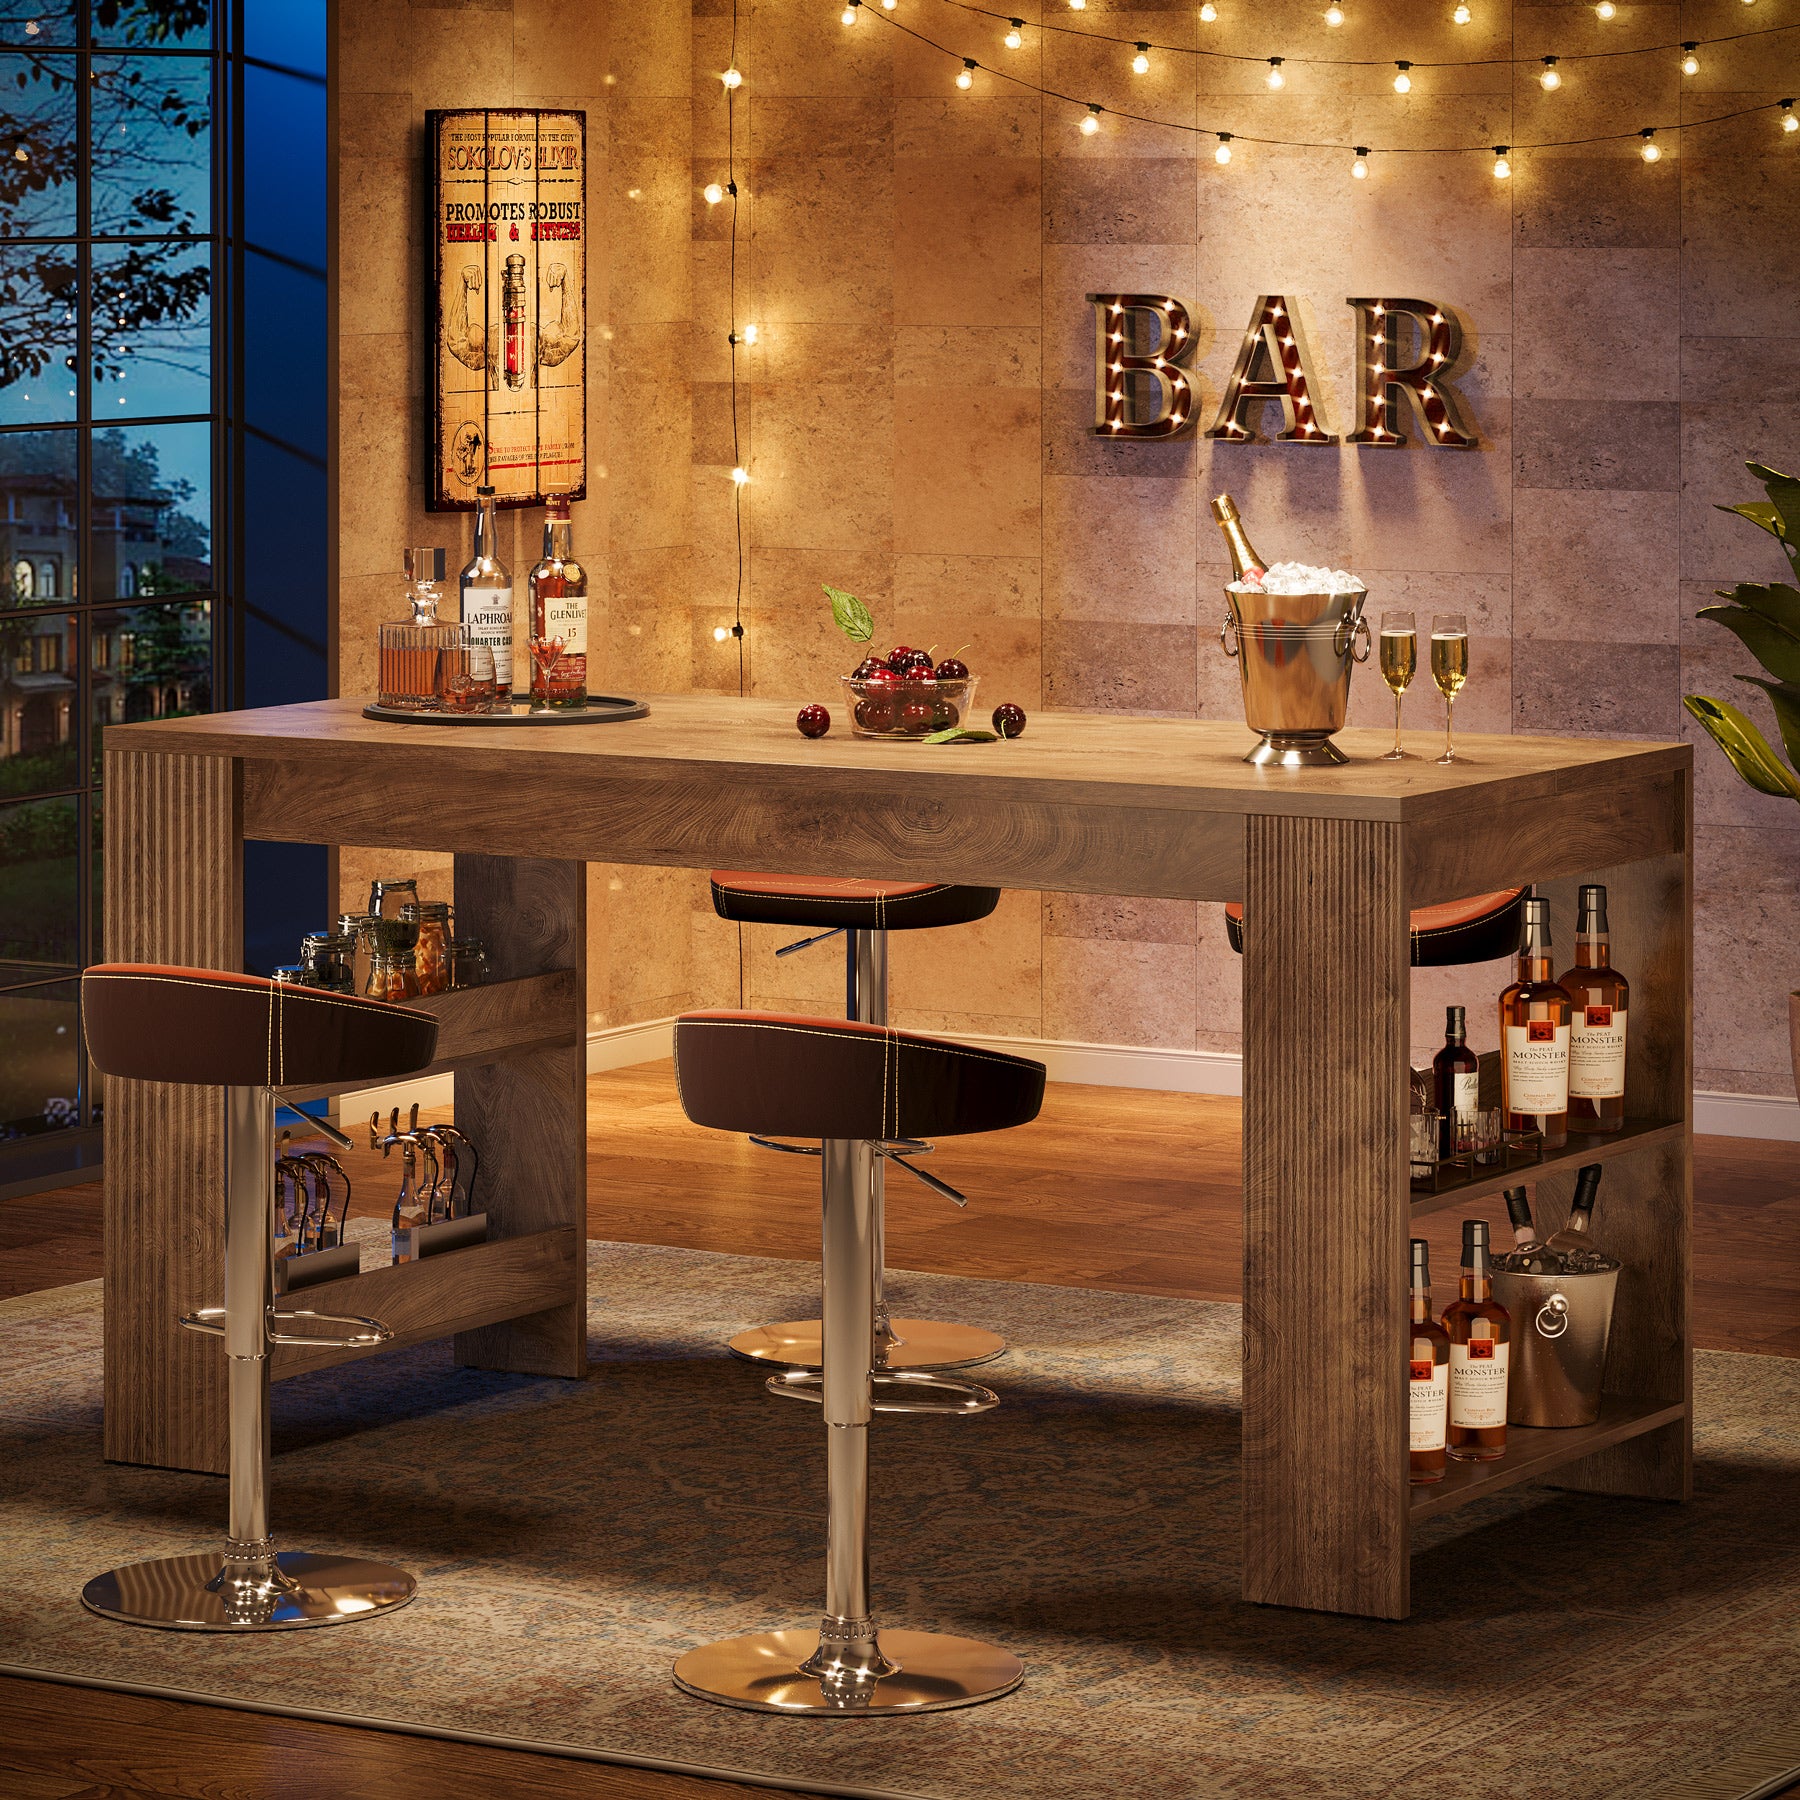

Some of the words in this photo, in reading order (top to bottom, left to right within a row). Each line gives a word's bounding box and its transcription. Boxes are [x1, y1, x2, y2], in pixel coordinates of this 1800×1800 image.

[547, 133, 559, 142] THE
[446, 202, 525, 221] PROMOTES
[528, 202, 581, 220] ROBUST
[446, 222, 497, 242] HEALTH
[509, 222, 519, 242] &
[531, 221, 581, 241] FITNESS
[1085, 293, 1479, 446] BAR
[565, 602, 578, 610] THE
[550, 608, 587, 621] GLENLIVET
[568, 627, 577, 638] 15
[470, 636, 501, 646] QUARTER
[1571, 1035, 1623, 1044] MONSTER
[1513, 1051, 1567, 1059] MONSTER
[1454, 1367, 1505, 1376] MONSTER
[1410, 1389, 1444, 1398] NSTER
